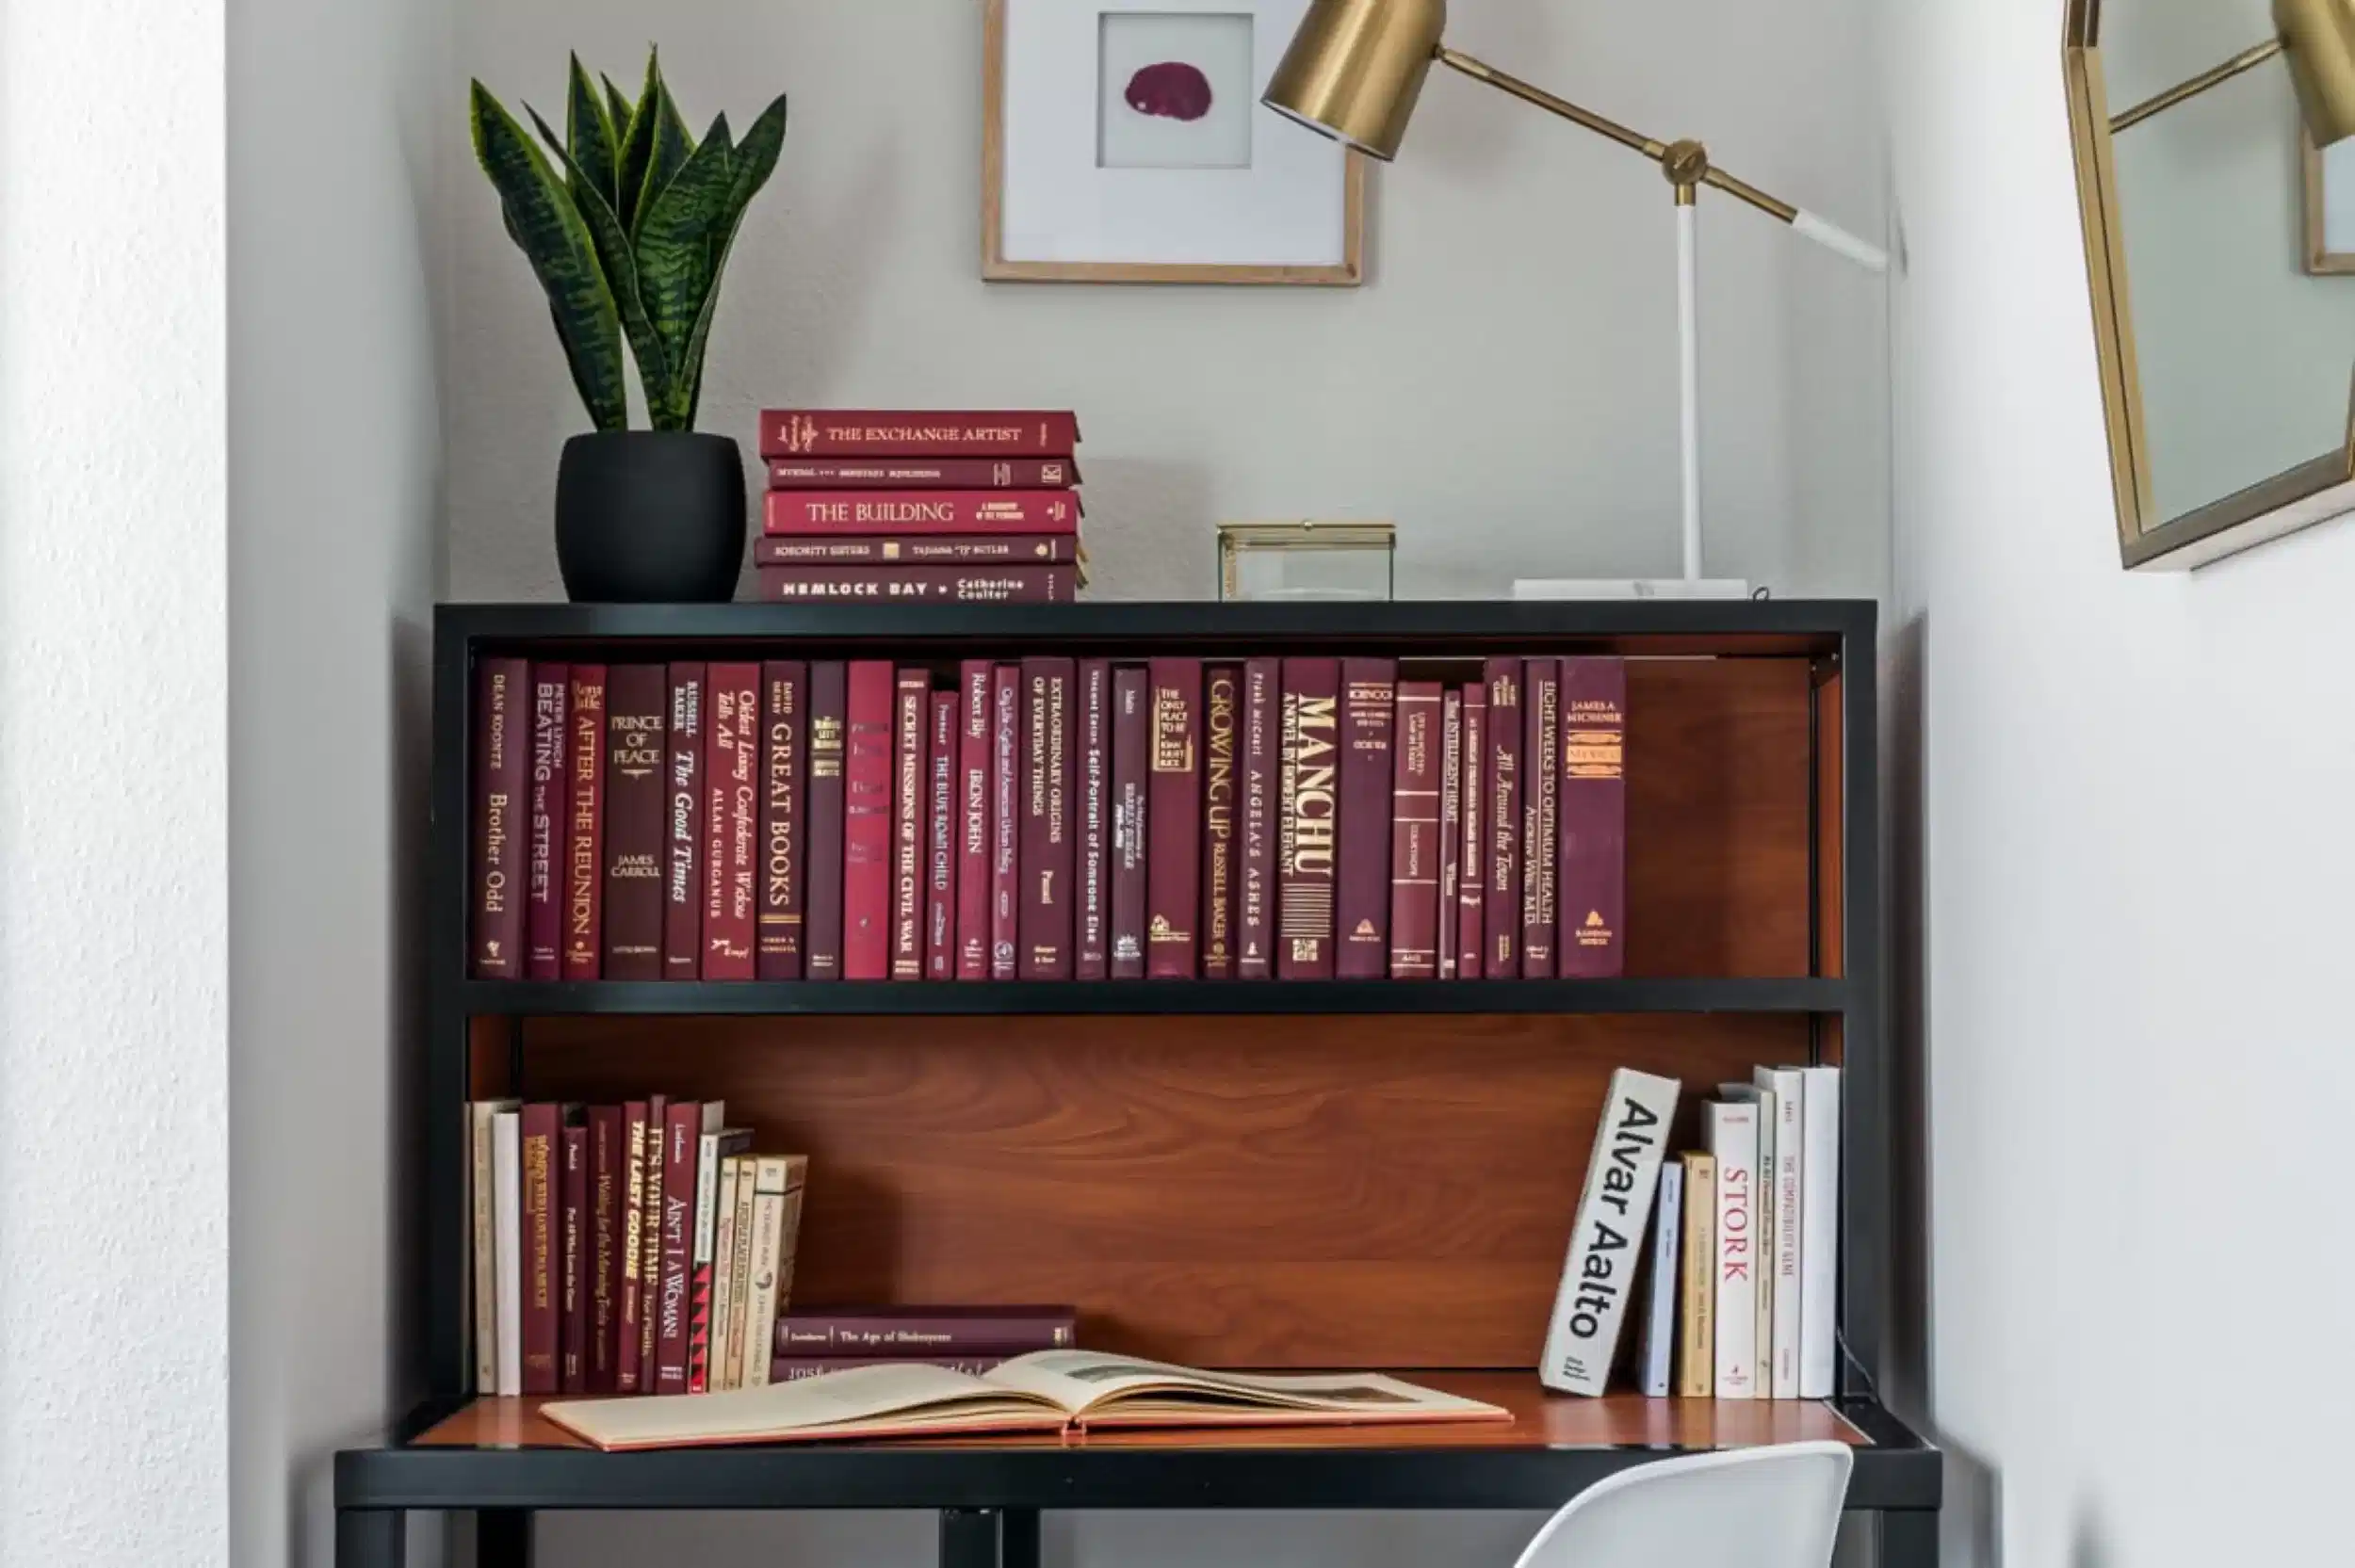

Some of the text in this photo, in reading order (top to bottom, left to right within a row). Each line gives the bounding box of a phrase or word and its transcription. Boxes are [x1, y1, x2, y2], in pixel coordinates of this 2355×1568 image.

[827, 428, 1022, 441] THE EXCHANGE ARTIST
[805, 503, 850, 522] THE
[855, 502, 954, 522] BUILDING
[783, 582, 928, 596] HEMLOCK BAY
[957, 578, 1024, 590] Catherine
[957, 590, 1009, 600] Coulter
[492, 674, 505, 710] DEAN
[967, 673, 985, 738] Robert Bly
[1032, 676, 1045, 694] OF
[1570, 701, 1605, 712] JAMES
[535, 682, 552, 781] BEATING
[553, 684, 564, 768] PETER LYNCH
[610, 716, 663, 731] PRINCE
[717, 723, 735, 750] All
[737, 690, 755, 736] Oldest
[903, 695, 917, 751] SECRET
[576, 717, 595, 781] AFTER
[613, 750, 660, 765] PEACE
[625, 733, 650, 748] OF
[733, 741, 754, 781] Living
[1048, 676, 1063, 844] EXTRAORDINARY ORIGINS
[1209, 680, 1234, 800] GROWING
[575, 786, 594, 830] THE
[901, 754, 916, 819] MISSIONS
[1031, 768, 1044, 816] THINGS
[1294, 693, 1337, 878] MANCHU
[1541, 681, 1556, 924] EIGHT WEEKS TO OPTIMUM HEALTH
[672, 751, 694, 903] The Good Times
[711, 788, 724, 832] ALLAN
[769, 722, 793, 906] GREAT BOOKS
[901, 822, 915, 842] OF
[967, 768, 983, 854] IRON JOHN
[1209, 805, 1230, 838] UP
[1495, 744, 1514, 892] All Around the Town
[485, 794, 508, 912] Brother Odd
[531, 815, 549, 903] STREET
[618, 854, 654, 865] JAMES
[901, 845, 914, 874] THE
[1086, 750, 1101, 942] Self-Portrait of Someone Else
[1246, 769, 1263, 927] ANGELA'S ASHES
[572, 836, 594, 935] REUNION
[735, 871, 752, 920] Widow
[901, 878, 914, 918] CIVIL
[900, 920, 914, 953] WAR
[631, 1121, 645, 1157] THE
[648, 1128, 664, 1166] IT'S
[1600, 1097, 1659, 1216] Alvar
[629, 1158, 644, 1207] LAST
[645, 1172, 663, 1228] YOUR
[665, 1195, 688, 1243] AIN'T
[1723, 1167, 1749, 1283] STORK
[643, 1232, 660, 1285] TIME
[667, 1260, 683, 1272] A
[1569, 1220, 1629, 1339] Aalto
[840, 1330, 859, 1342] The
[861, 1331, 881, 1346] Age
[884, 1330, 896, 1342] of
